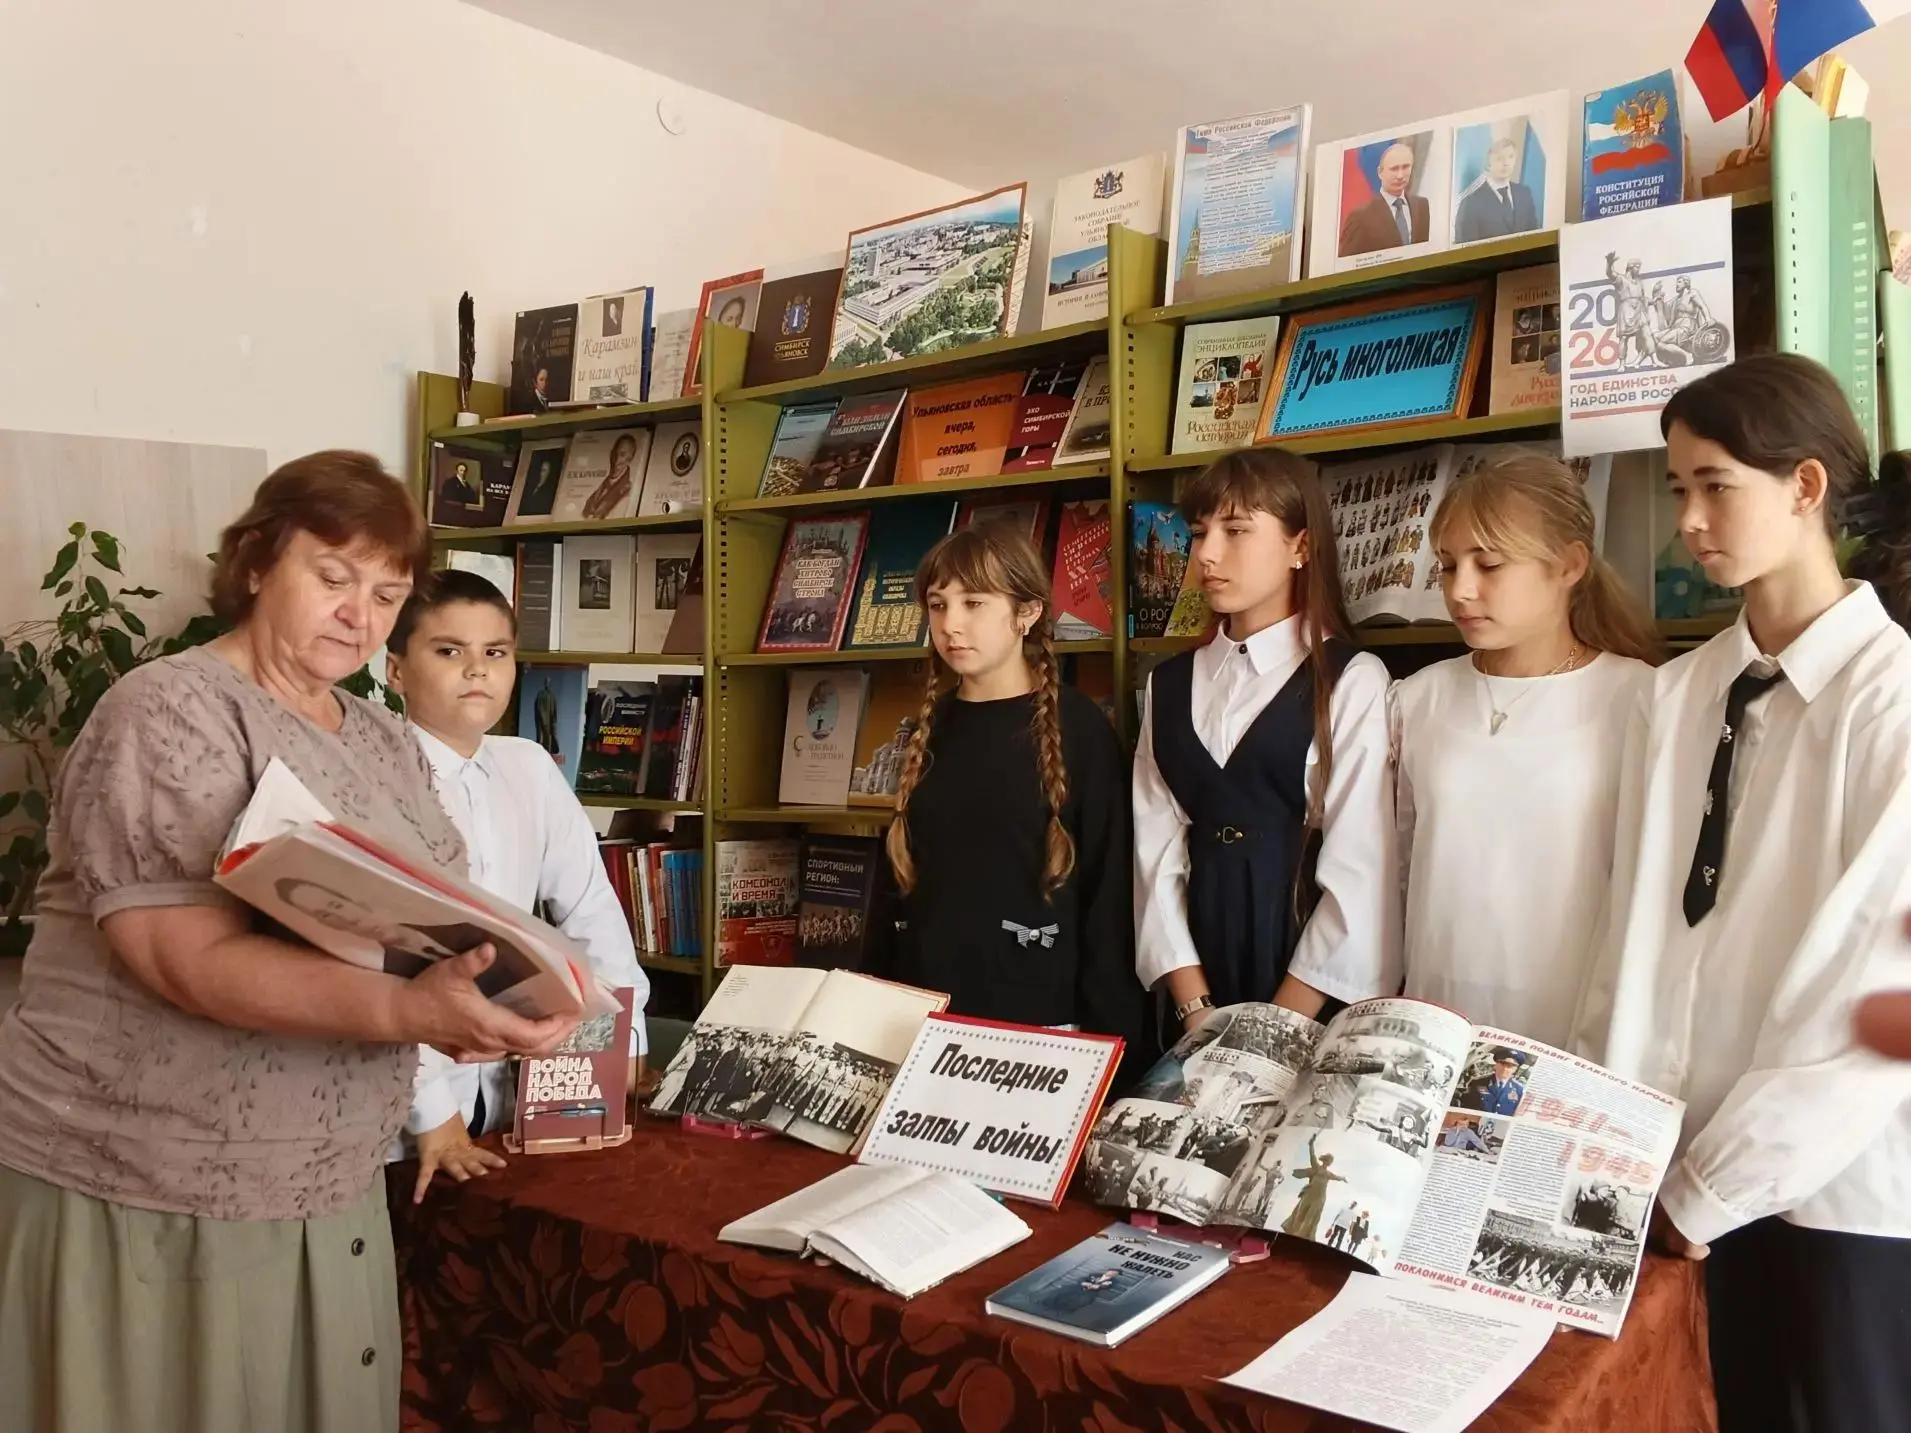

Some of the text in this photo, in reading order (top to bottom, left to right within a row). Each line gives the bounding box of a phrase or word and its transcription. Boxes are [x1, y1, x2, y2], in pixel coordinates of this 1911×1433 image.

[1595, 174, 1664, 194] КОНСТИТУЦИЯ
[1599, 185, 1660, 205] РОССИЙСКОЙ
[1599, 198, 1658, 215] ФЕДЕРАЦИИ
[1569, 289, 1618, 330] 20
[1569, 327, 1619, 369] 26
[1292, 325, 1462, 401] Русь многоликая
[1570, 373, 1677, 395] ГОД ЕДИНСТВА
[1570, 386, 1681, 408] НАРОДОВ РОСС
[913, 401, 971, 418] Ульяновская
[1024, 410, 1071, 424] СИМБИРСКОЙ
[1026, 407, 1040, 415] ЭХО
[944, 421, 976, 434] вчера,
[1021, 425, 1040, 433] ГОРЫ
[937, 442, 977, 457] сегодня,
[938, 464, 970, 477] завтра
[599, 725, 642, 736] РОССИЙСКОЙ
[807, 858, 864, 874] СПОРТИВНЫЙ
[732, 877, 788, 890] КОМСОМОЛ
[806, 871, 840, 885] РЕГИОН:
[732, 889, 776, 901] И ВРЕМЯ
[529, 1056, 593, 1074] ВОЙНА
[930, 1043, 1069, 1094] Последние
[1478, 1030, 1675, 1107] ВЕЛИКИЙ ПОДВИГ ВЕЛИКОГО НАРОДА
[528, 1071, 592, 1088] НАРОД
[526, 1084, 602, 1103] ПОБЕДА
[886, 1109, 1064, 1165] залпы войны
[1108, 1244, 1191, 1271] НЕ НУЖНО
[1172, 1250, 1202, 1262] НАС
[1121, 1260, 1174, 1279] ЖАЛЕТЬ
[1394, 1262, 1468, 1289] ПОКЛОНИМСЯ
[1471, 1282, 1526, 1304] ВЕЛИКИМ
[1530, 1298, 1554, 1312] ТЕМ
